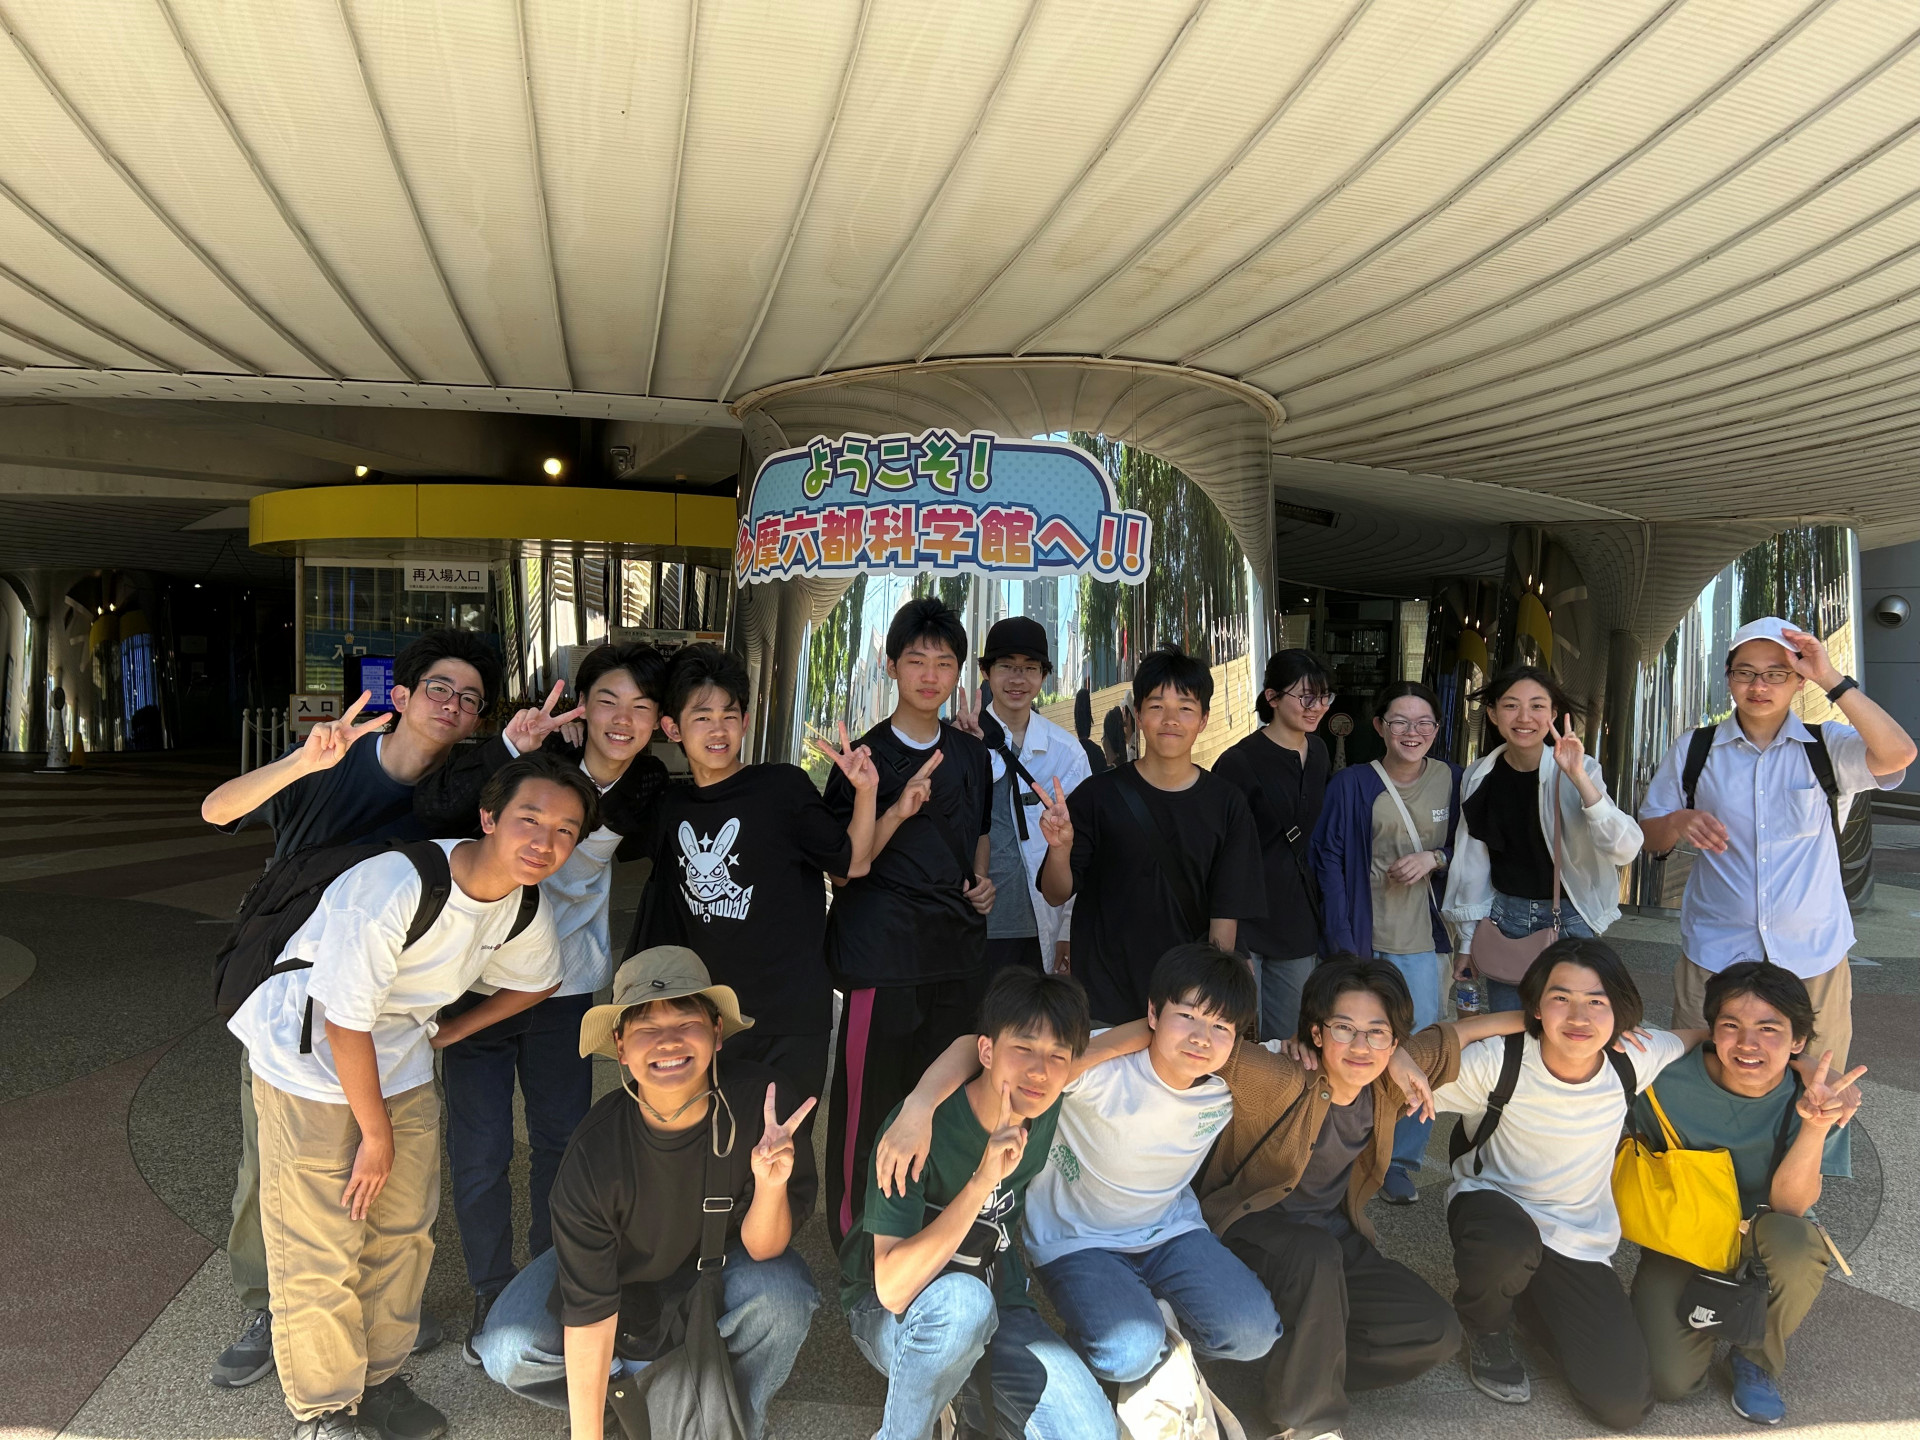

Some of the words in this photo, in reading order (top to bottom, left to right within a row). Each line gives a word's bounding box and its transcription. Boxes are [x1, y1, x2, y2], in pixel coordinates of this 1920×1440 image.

[804, 433, 990, 497] ようこそ！
[737, 506, 1144, 574] 多摩六都科学館へ！！
[412, 568, 480, 582] 再入場入口
[298, 701, 333, 712] 入口
[1692, 1305, 1716, 1323] NIKE
